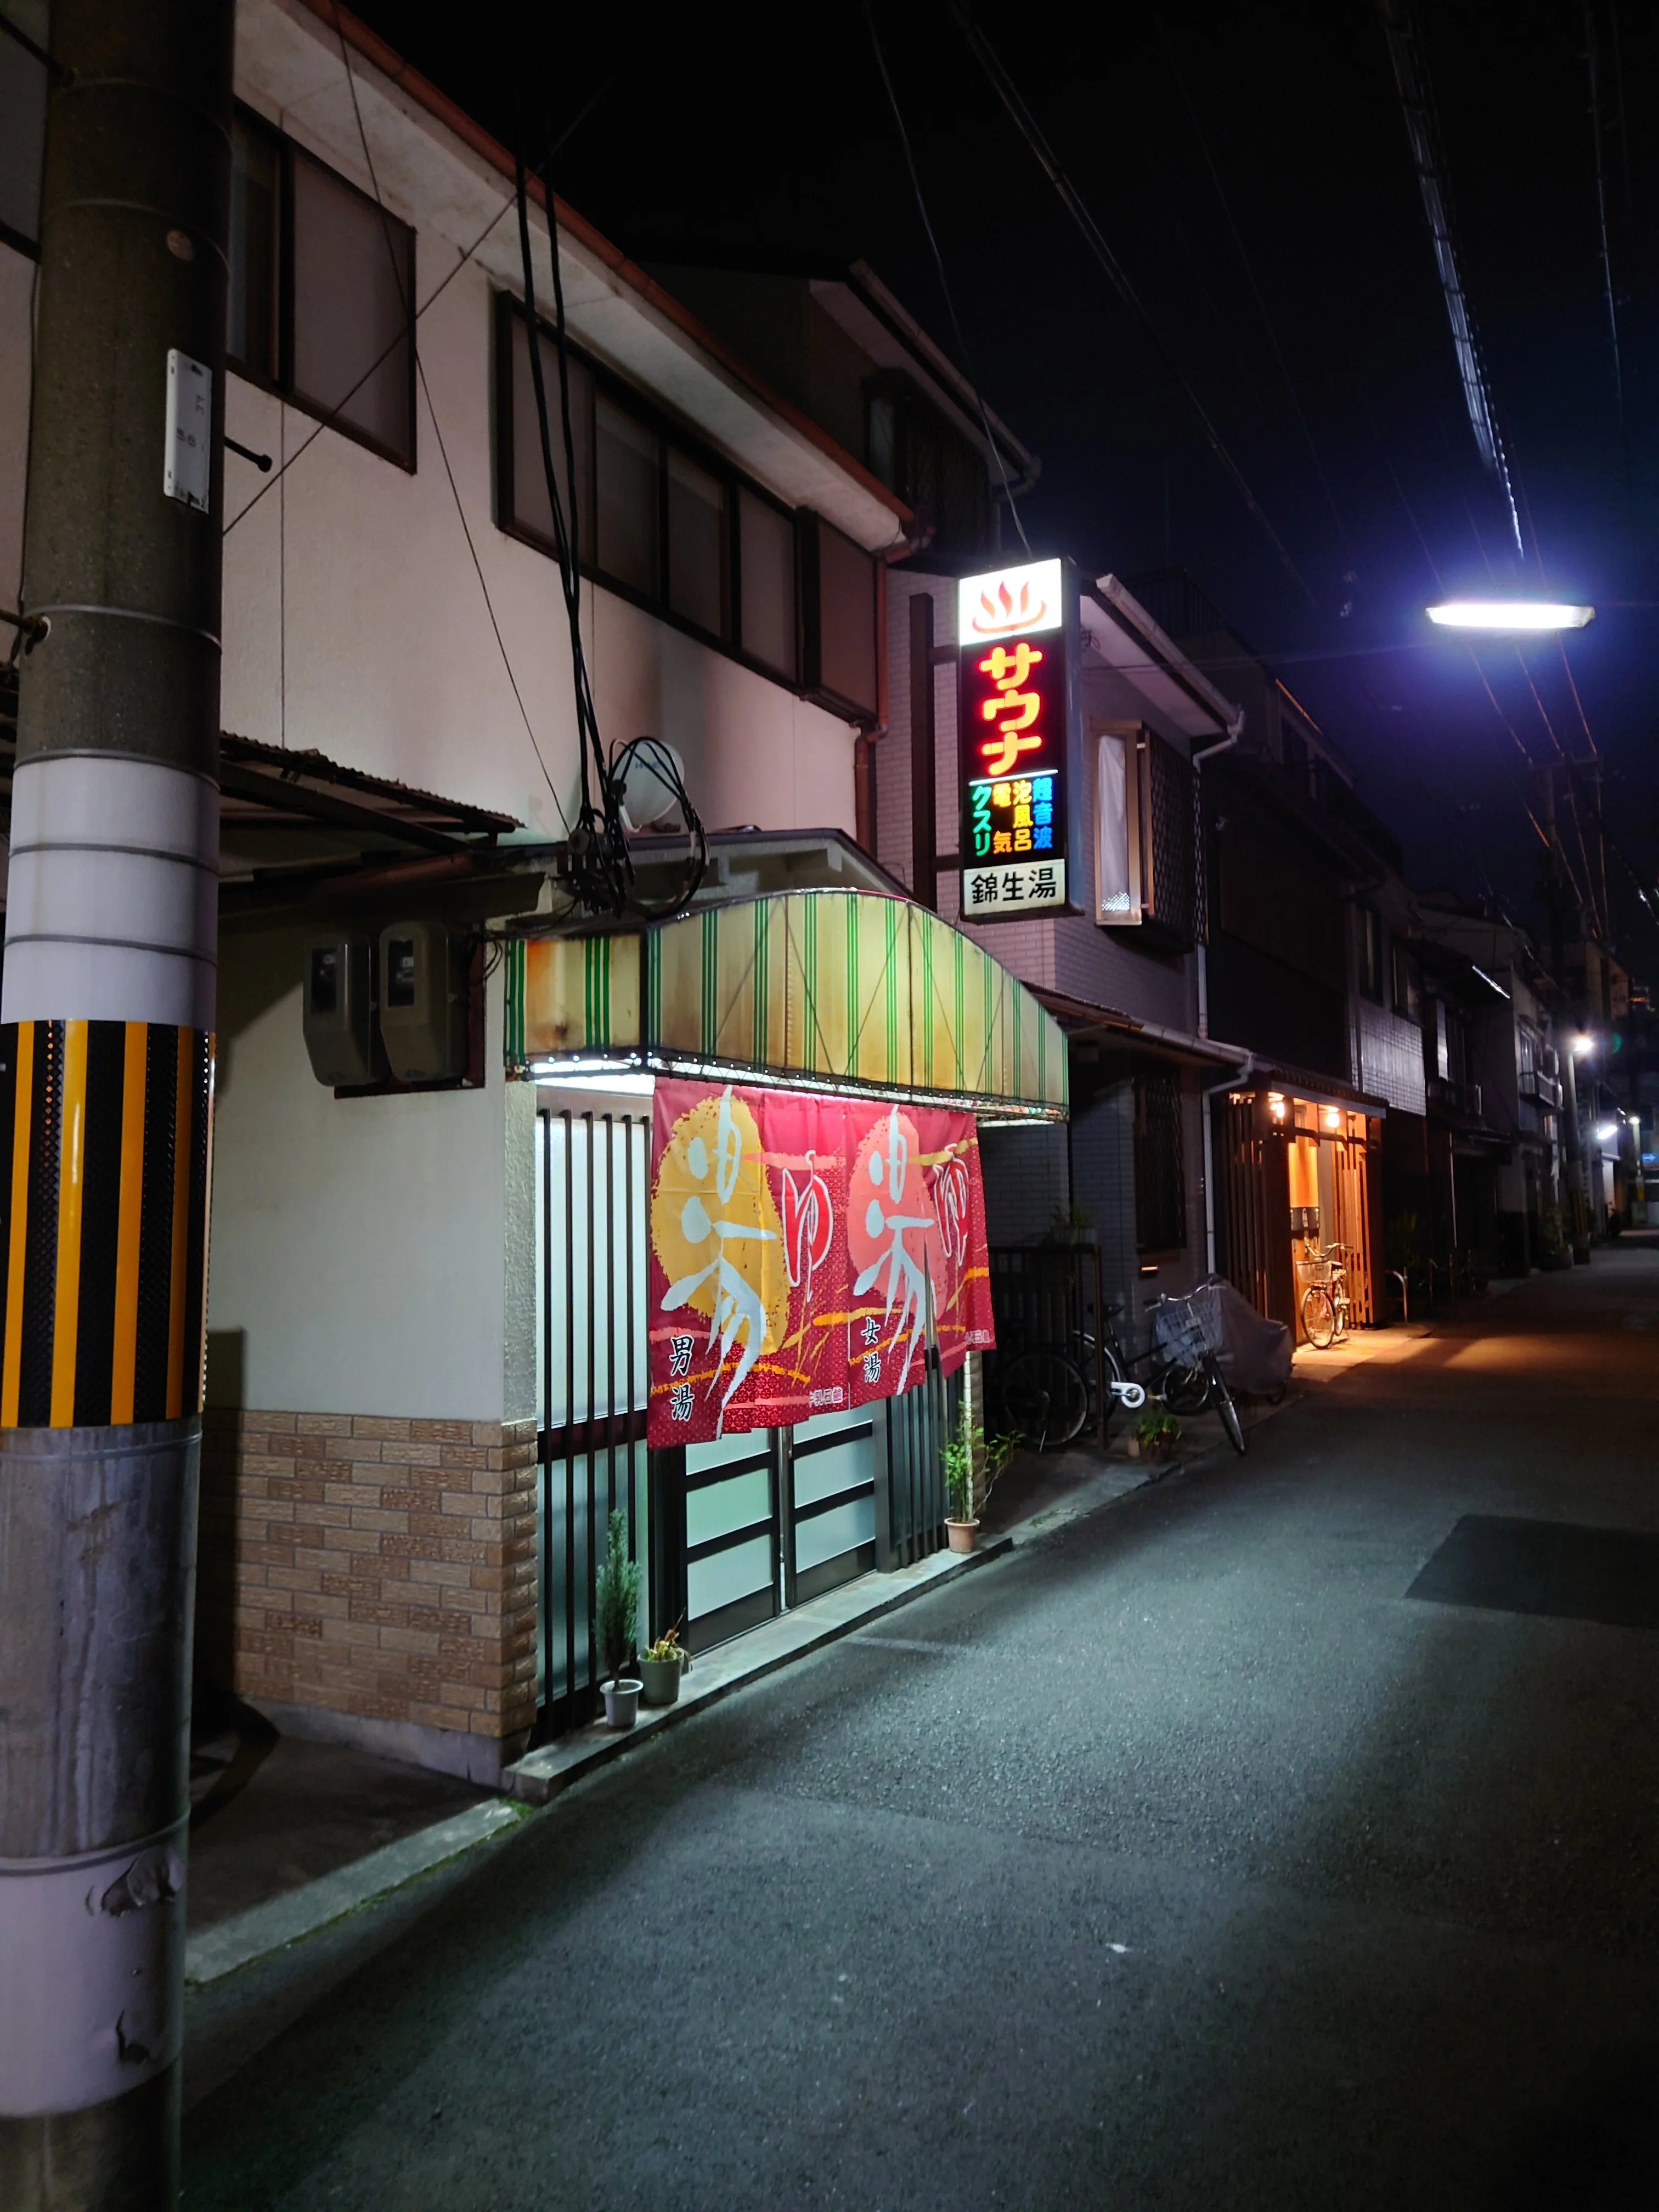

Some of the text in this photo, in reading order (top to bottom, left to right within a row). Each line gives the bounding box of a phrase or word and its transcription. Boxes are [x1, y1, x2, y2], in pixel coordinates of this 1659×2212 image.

[979, 642, 1043, 776] サウナ
[973, 786, 991, 856] クスリ
[992, 782, 1012, 854] 電気
[1013, 780, 1033, 851] 泡風呂
[1032, 777, 1053, 849] 超音波
[971, 867, 1057, 904] 錦生湯
[669, 1335, 695, 1422] 男湯
[861, 1317, 881, 1383] 女湯
